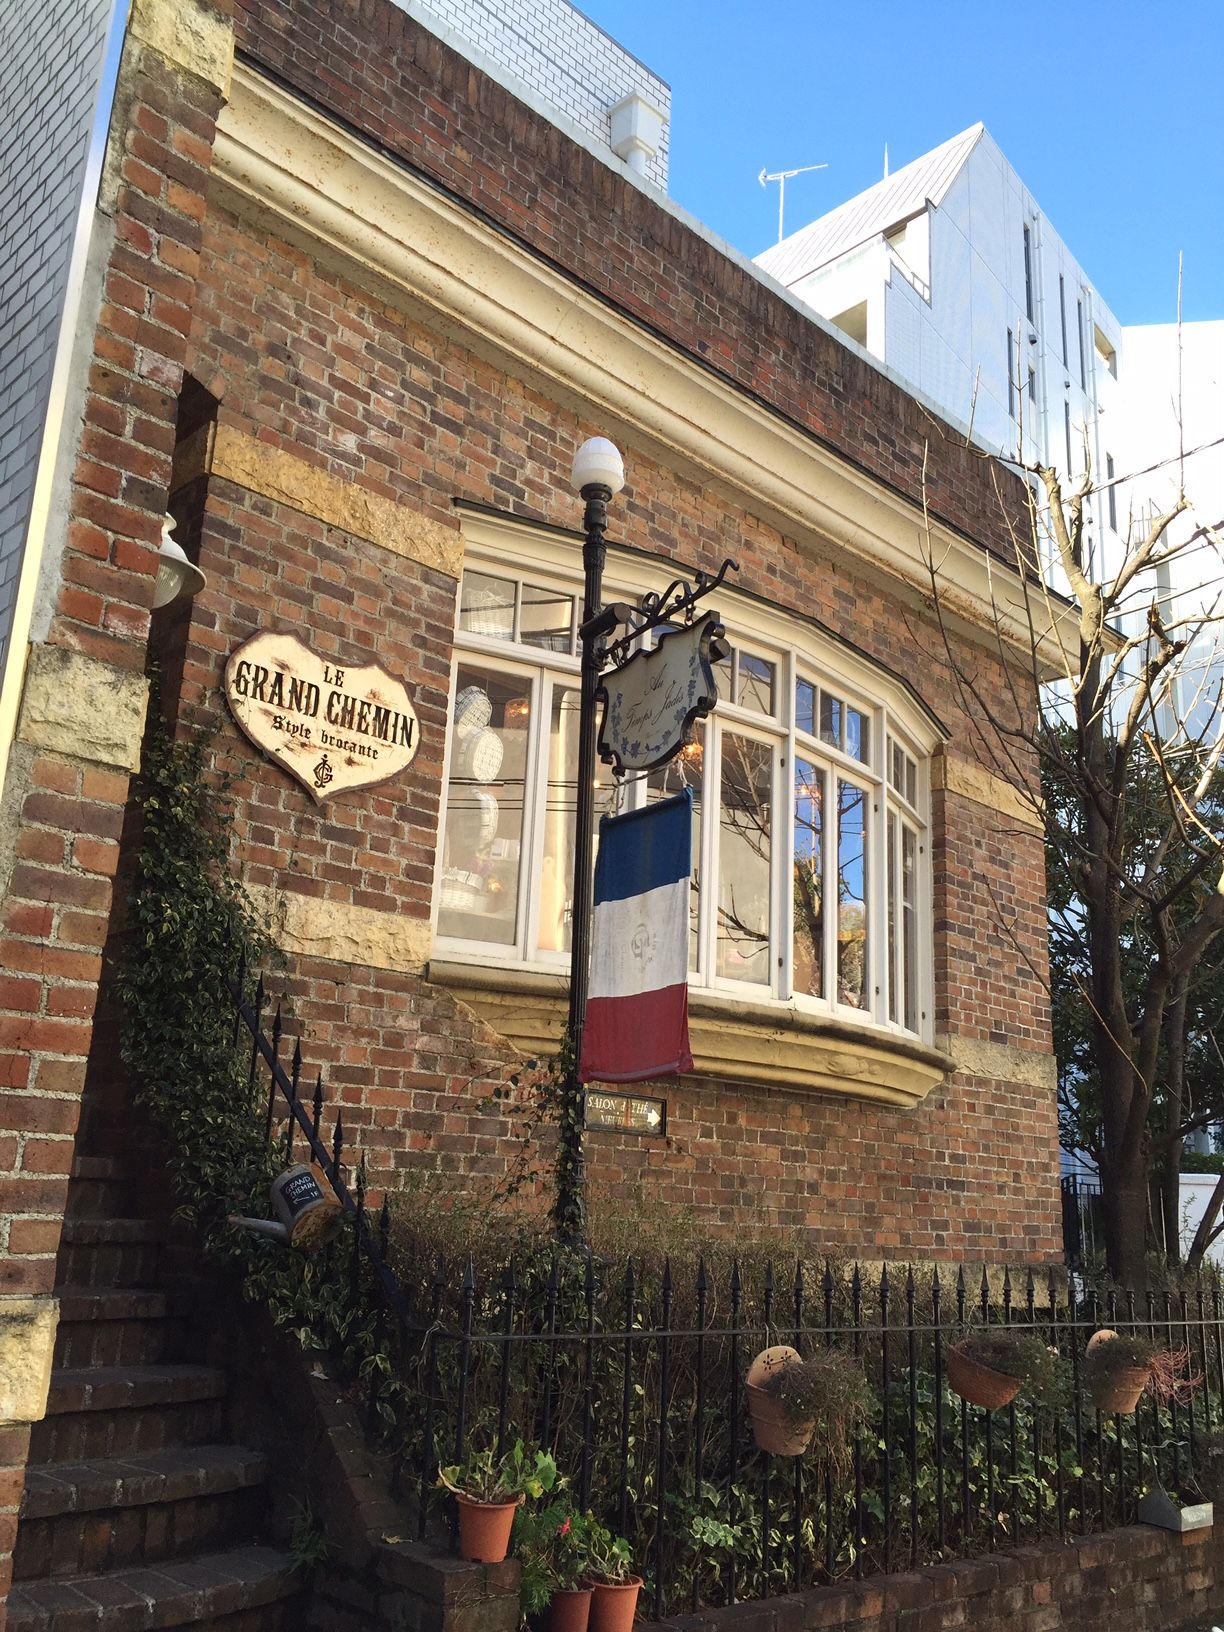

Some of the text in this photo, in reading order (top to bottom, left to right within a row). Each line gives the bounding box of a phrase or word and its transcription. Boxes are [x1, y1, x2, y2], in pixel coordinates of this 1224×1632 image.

[322, 665, 346, 688] LE
[232, 660, 415, 749] GRAND CHEMIN
[622, 680, 684, 733] Temps Jadis
[272, 714, 379, 760] Style brocante
[587, 1096, 617, 1110] SALON
[285, 1176, 311, 1193] GRAND
[290, 1181, 316, 1198] CHEMIN
